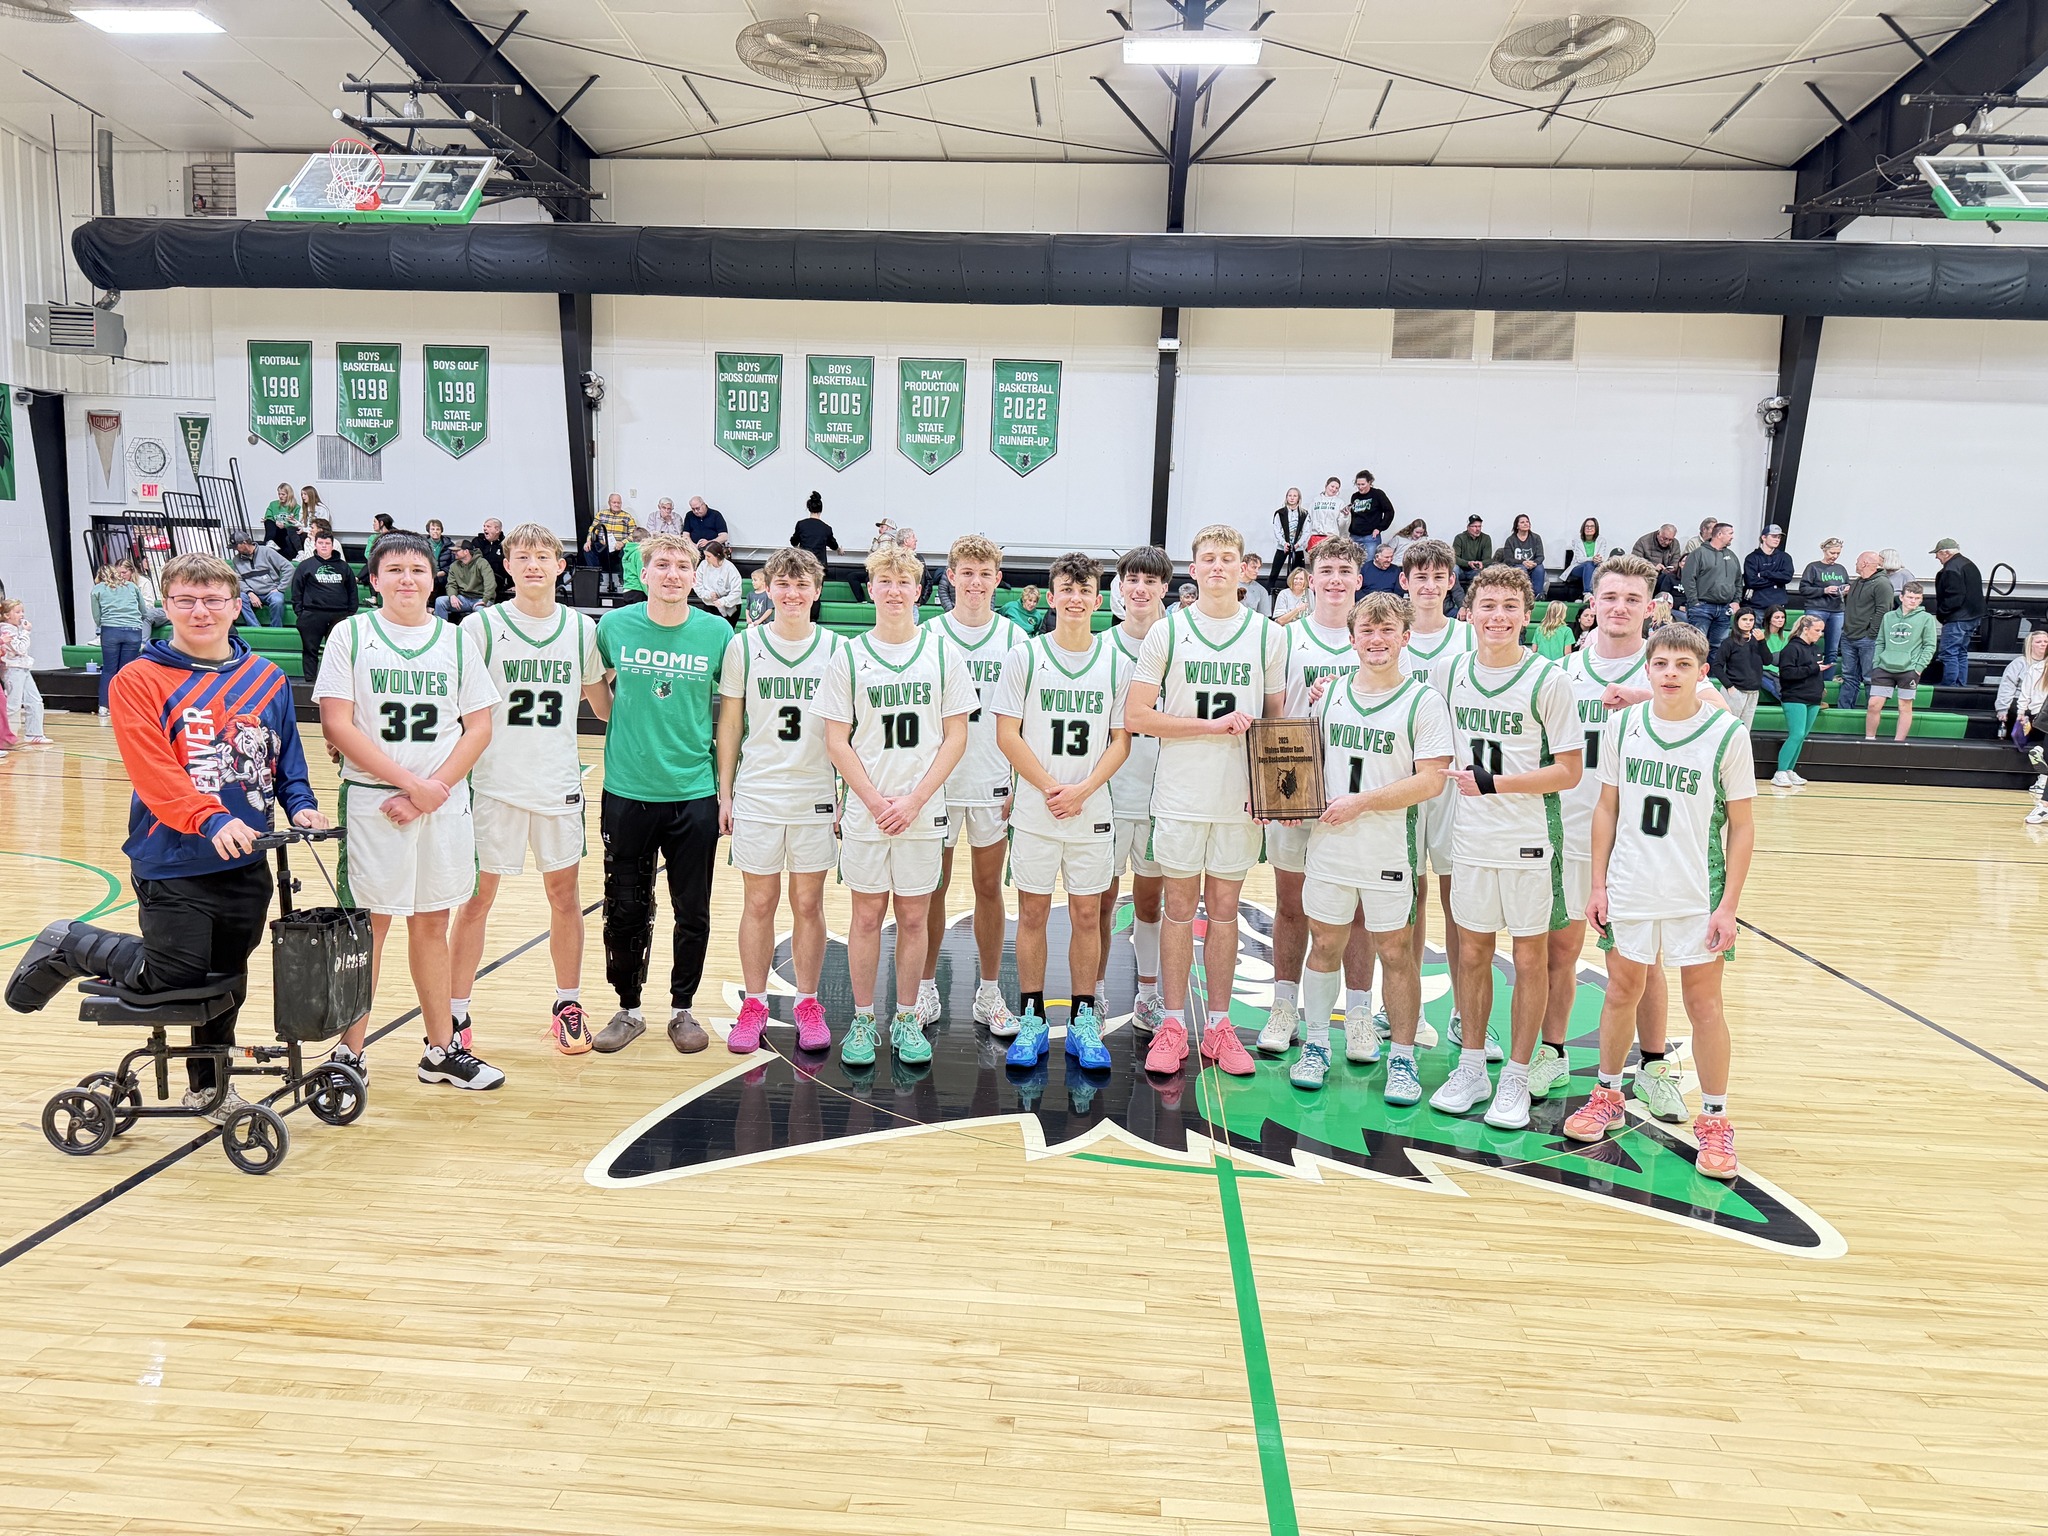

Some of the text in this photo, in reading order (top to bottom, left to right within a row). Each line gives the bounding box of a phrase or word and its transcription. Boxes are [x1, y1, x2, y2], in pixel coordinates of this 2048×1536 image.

[259, 356, 301, 366] FOOTBALL
[357, 351, 380, 361] BOYS
[343, 362, 396, 373] BASKETBALL
[433, 360, 479, 371] BOYS GOLF
[737, 362, 761, 372] BOYS
[828, 364, 852, 375] BOYS
[719, 372, 779, 384] CROSS COUNTRY
[812, 375, 868, 387] BASKETBALL
[920, 370, 943, 380] PLAY
[1015, 371, 1039, 382] BOYS
[262, 376, 299, 398] 1998
[350, 378, 388, 401] 1998
[437, 381, 476, 404] 1998
[904, 381, 960, 393] PRODUCTION
[999, 382, 1055, 394] BASKETBALL
[727, 389, 770, 414] 2003
[818, 392, 861, 416] 2005
[911, 395, 951, 419] 2017
[1003, 396, 1047, 420] 2022
[268, 405, 295, 415] STATE
[357, 408, 383, 418] STATE
[443, 410, 471, 421] STATE
[93, 416, 118, 430] LOOMIS
[256, 416, 307, 426] RUNNER-UP
[345, 418, 394, 429] RUNNER-UP
[431, 420, 483, 432] RUNNER-UP
[735, 419, 762, 430] STATE
[826, 422, 853, 433] STATE
[917, 423, 945, 433] STATE
[1011, 424, 1038, 435] STATE
[723, 430, 774, 442] RUNNER-UP
[814, 433, 865, 445] RUNNER-UP
[905, 433, 957, 445] RUNNER-UP
[999, 435, 1050, 447] RUNNER-UP
[186, 419, 201, 474] LOOMIS
[142, 483, 158, 496] EXIT
[315, 573, 343, 581] WOLVES
[620, 645, 709, 672] LOOMIS
[502, 659, 572, 684] WOLVES
[620, 666, 706, 682] FOOTBALL
[966, 660, 1002, 682] VES
[1184, 661, 1251, 686] WOLVES
[370, 668, 447, 697] WOLVES
[867, 682, 932, 708] WOLVES
[1040, 688, 1104, 714] WOLVES
[507, 688, 563, 728] 23
[1195, 691, 1237, 720] 12
[380, 701, 438, 743] 32
[777, 706, 802, 742] 3
[1455, 706, 1524, 735] WOLVES
[881, 712, 920, 750] 10
[1051, 718, 1090, 757] 13
[1329, 723, 1396, 755] WOLVES
[182, 707, 222, 805] ENVER
[1264, 746, 1280, 754] Wolves
[1583, 730, 1606, 769] 1
[1268, 755, 1290, 763] Basketball
[1348, 755, 1365, 794] 1
[1625, 757, 1701, 796] WOLVES
[1640, 794, 1673, 838] 0
